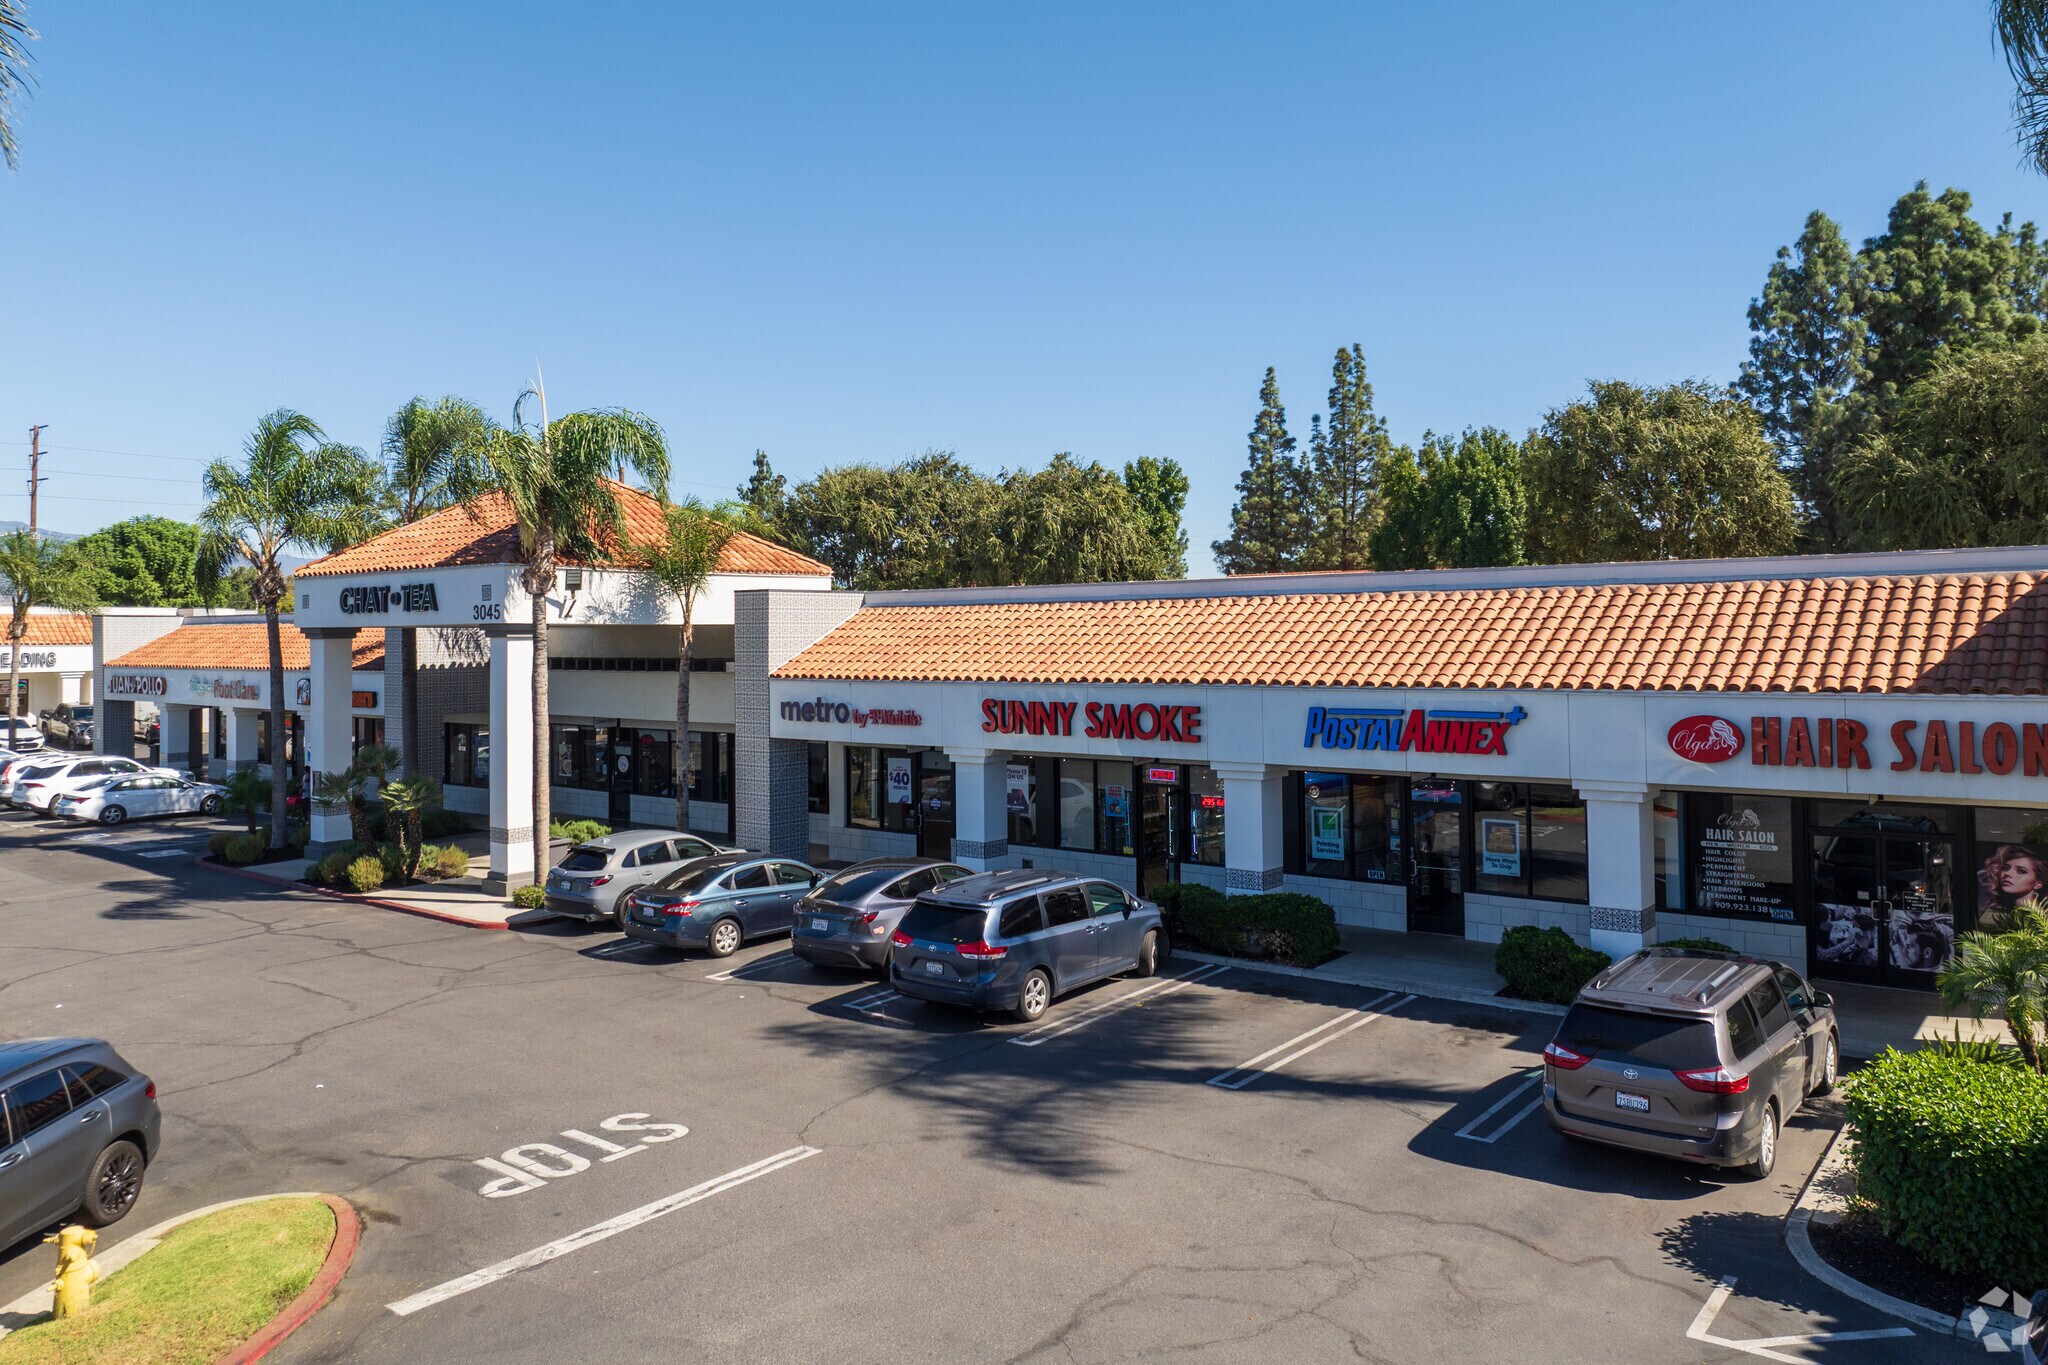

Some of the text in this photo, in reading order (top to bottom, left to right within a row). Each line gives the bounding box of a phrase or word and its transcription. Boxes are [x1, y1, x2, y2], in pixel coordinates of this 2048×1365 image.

[340, 583, 440, 615] CHAT TEA
[473, 604, 501, 621] 3045
[135, 678, 167, 696] POLLO
[780, 697, 850, 724] metro
[852, 709, 869, 728] by
[981, 698, 1201, 743] SUNNY SMOKE
[1751, 716, 2048, 777] HAIR SALON
[889, 771, 910, 785] $40
[1151, 770, 1175, 780] OPEN
[1705, 828, 1775, 843] HAIR SALON
[1316, 841, 1339, 849] Printing
[1316, 847, 1340, 855] Services
[1705, 856, 1745, 864] HIGHLIGHTS
[1705, 871, 1755, 879] STRAIGHTENED
[1725, 880, 1766, 888] EXTENSIONS
[1706, 892, 1781, 904] PERMANENT MAKE-UP
[1714, 901, 1772, 913] 909.923.1381
[1618, 1096, 1648, 1110] 7SBU396
[473, 1112, 690, 1198] STOP
